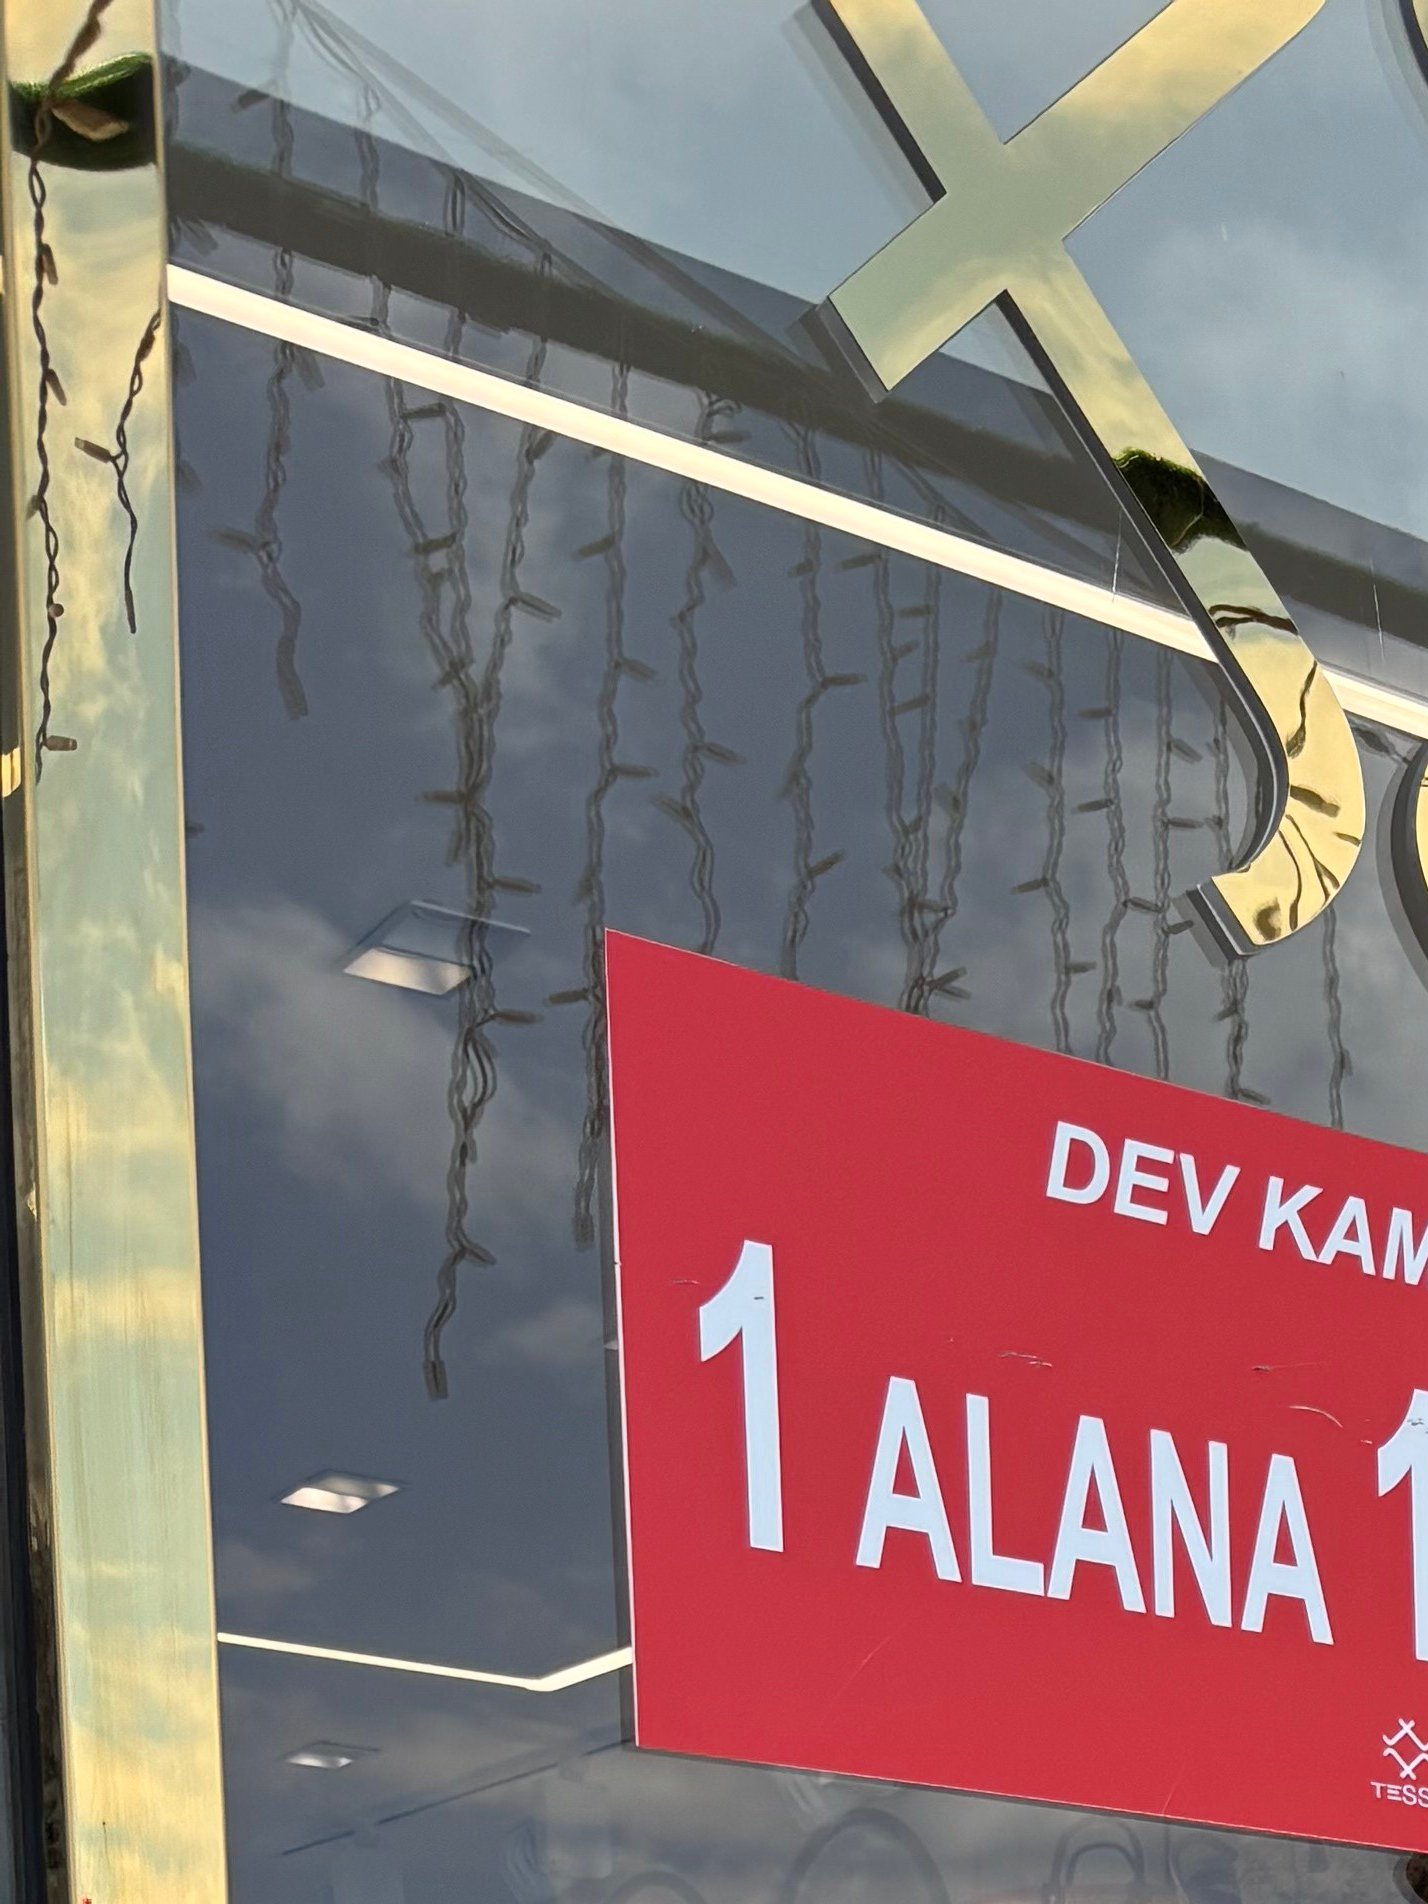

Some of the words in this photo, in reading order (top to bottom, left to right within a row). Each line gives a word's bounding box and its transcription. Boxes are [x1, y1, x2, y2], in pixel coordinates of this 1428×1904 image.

[1045, 1120, 1241, 1236] DEV
[698, 1239, 784, 1553] 1
[855, 1375, 1334, 1646] ALANA
